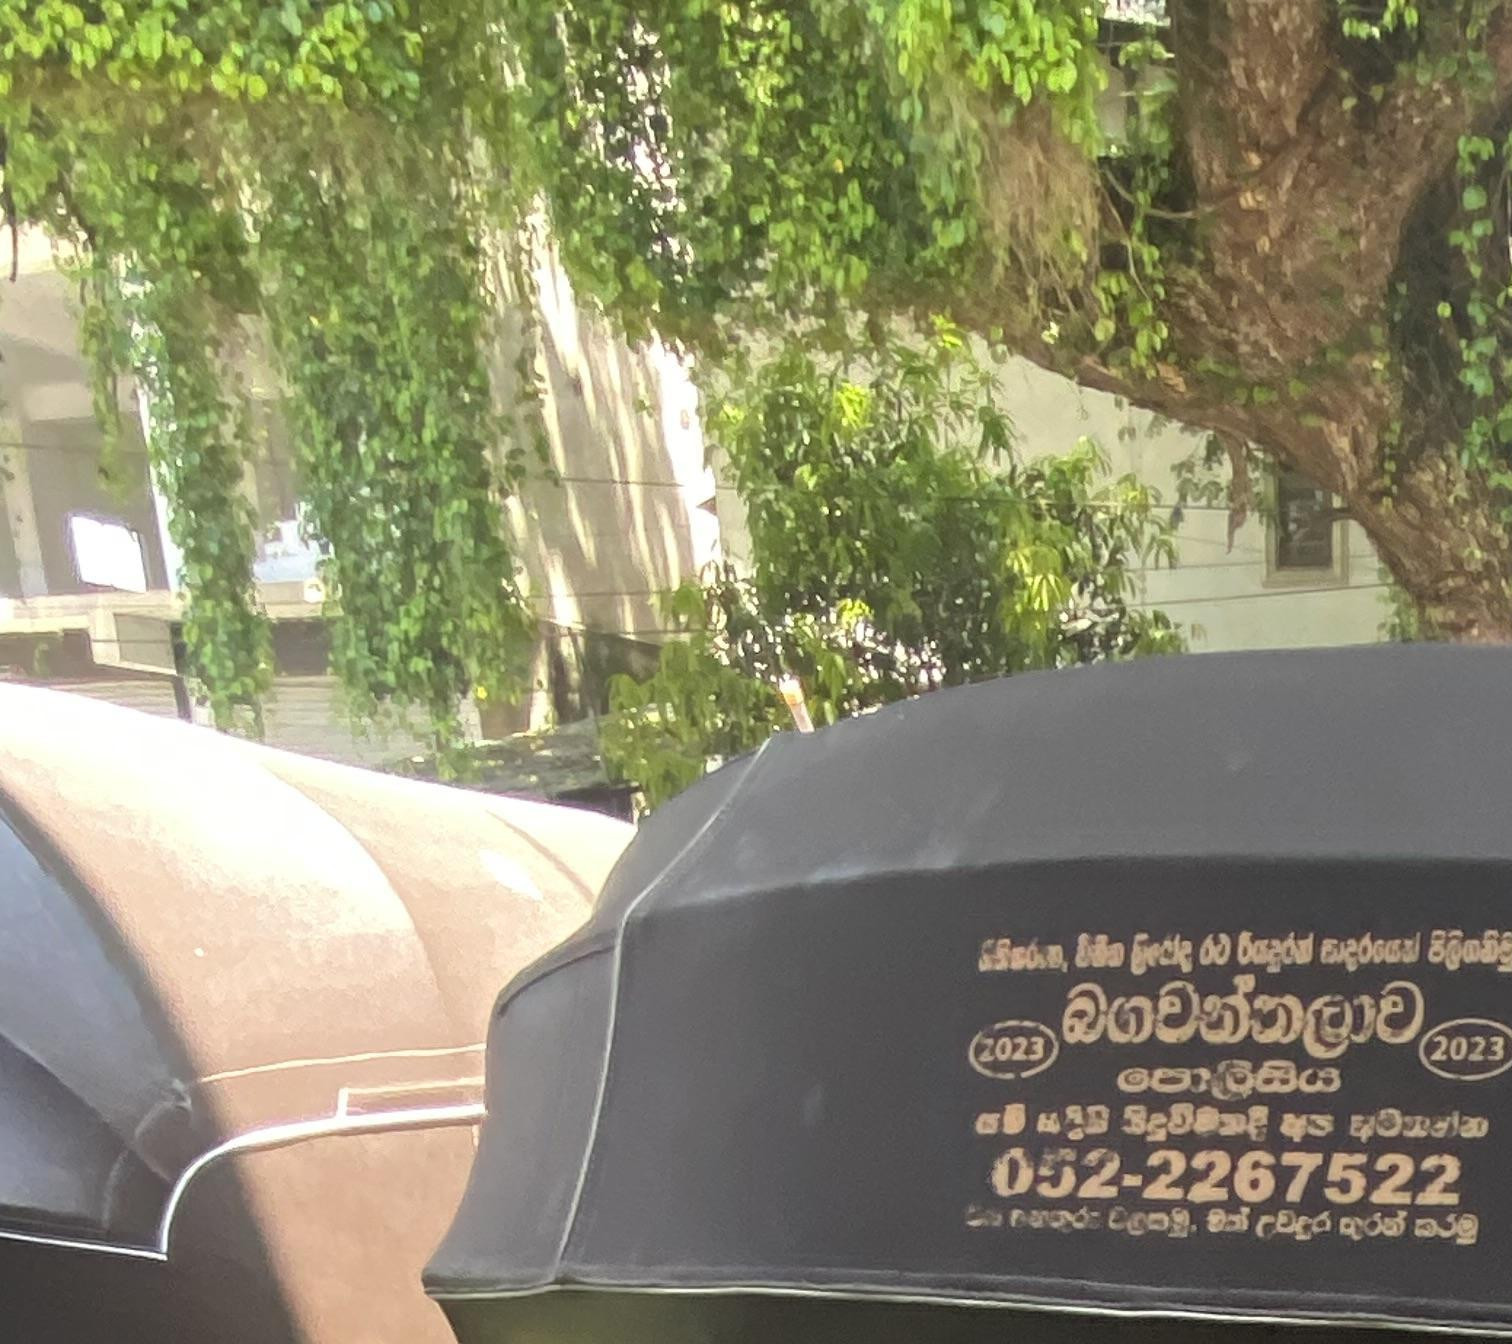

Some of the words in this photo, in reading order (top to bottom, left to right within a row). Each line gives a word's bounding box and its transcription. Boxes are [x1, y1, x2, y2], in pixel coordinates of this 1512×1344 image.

[975, 1034, 1045, 1063] 2023
[1429, 1034, 1506, 1064] 2023
[989, 1146, 1462, 1206] 052-2267522
